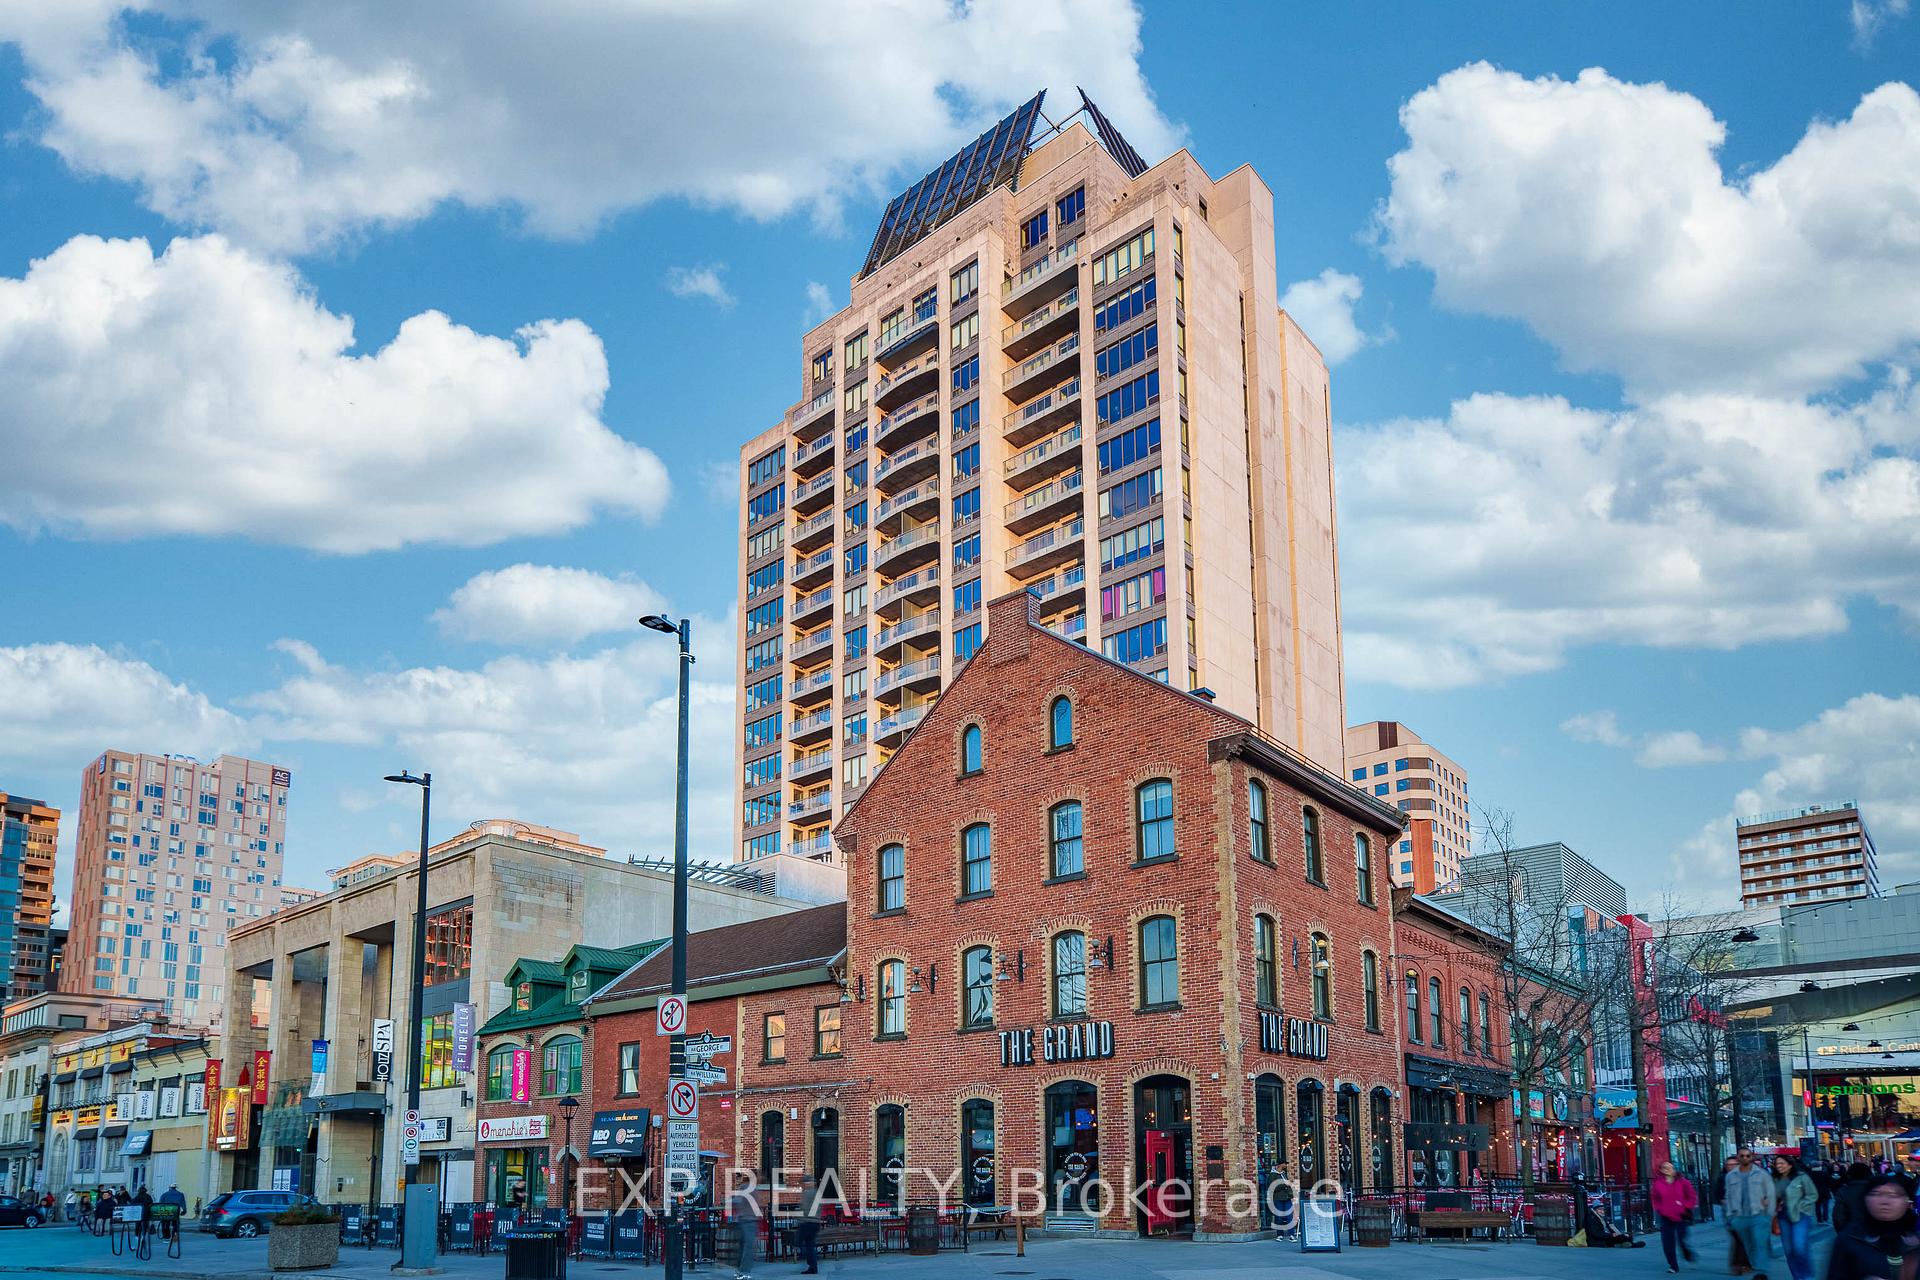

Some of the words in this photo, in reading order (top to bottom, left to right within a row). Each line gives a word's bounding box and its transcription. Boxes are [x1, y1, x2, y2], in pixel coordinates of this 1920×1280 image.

[376, 1023, 391, 1051] SPA
[457, 1007, 469, 1063] FIORELLA
[998, 1028, 1034, 1067] THE
[1043, 1020, 1113, 1062] GRAND
[1260, 1011, 1284, 1052] THE
[1289, 1018, 1328, 1059] GRAND
[696, 1043, 720, 1052] GEORGE
[695, 1070, 719, 1079] WILLIAM
[675, 1123, 692, 1131] EXCEPT
[672, 1153, 684, 1161] SAUF
[686, 1153, 695, 1161] LES
